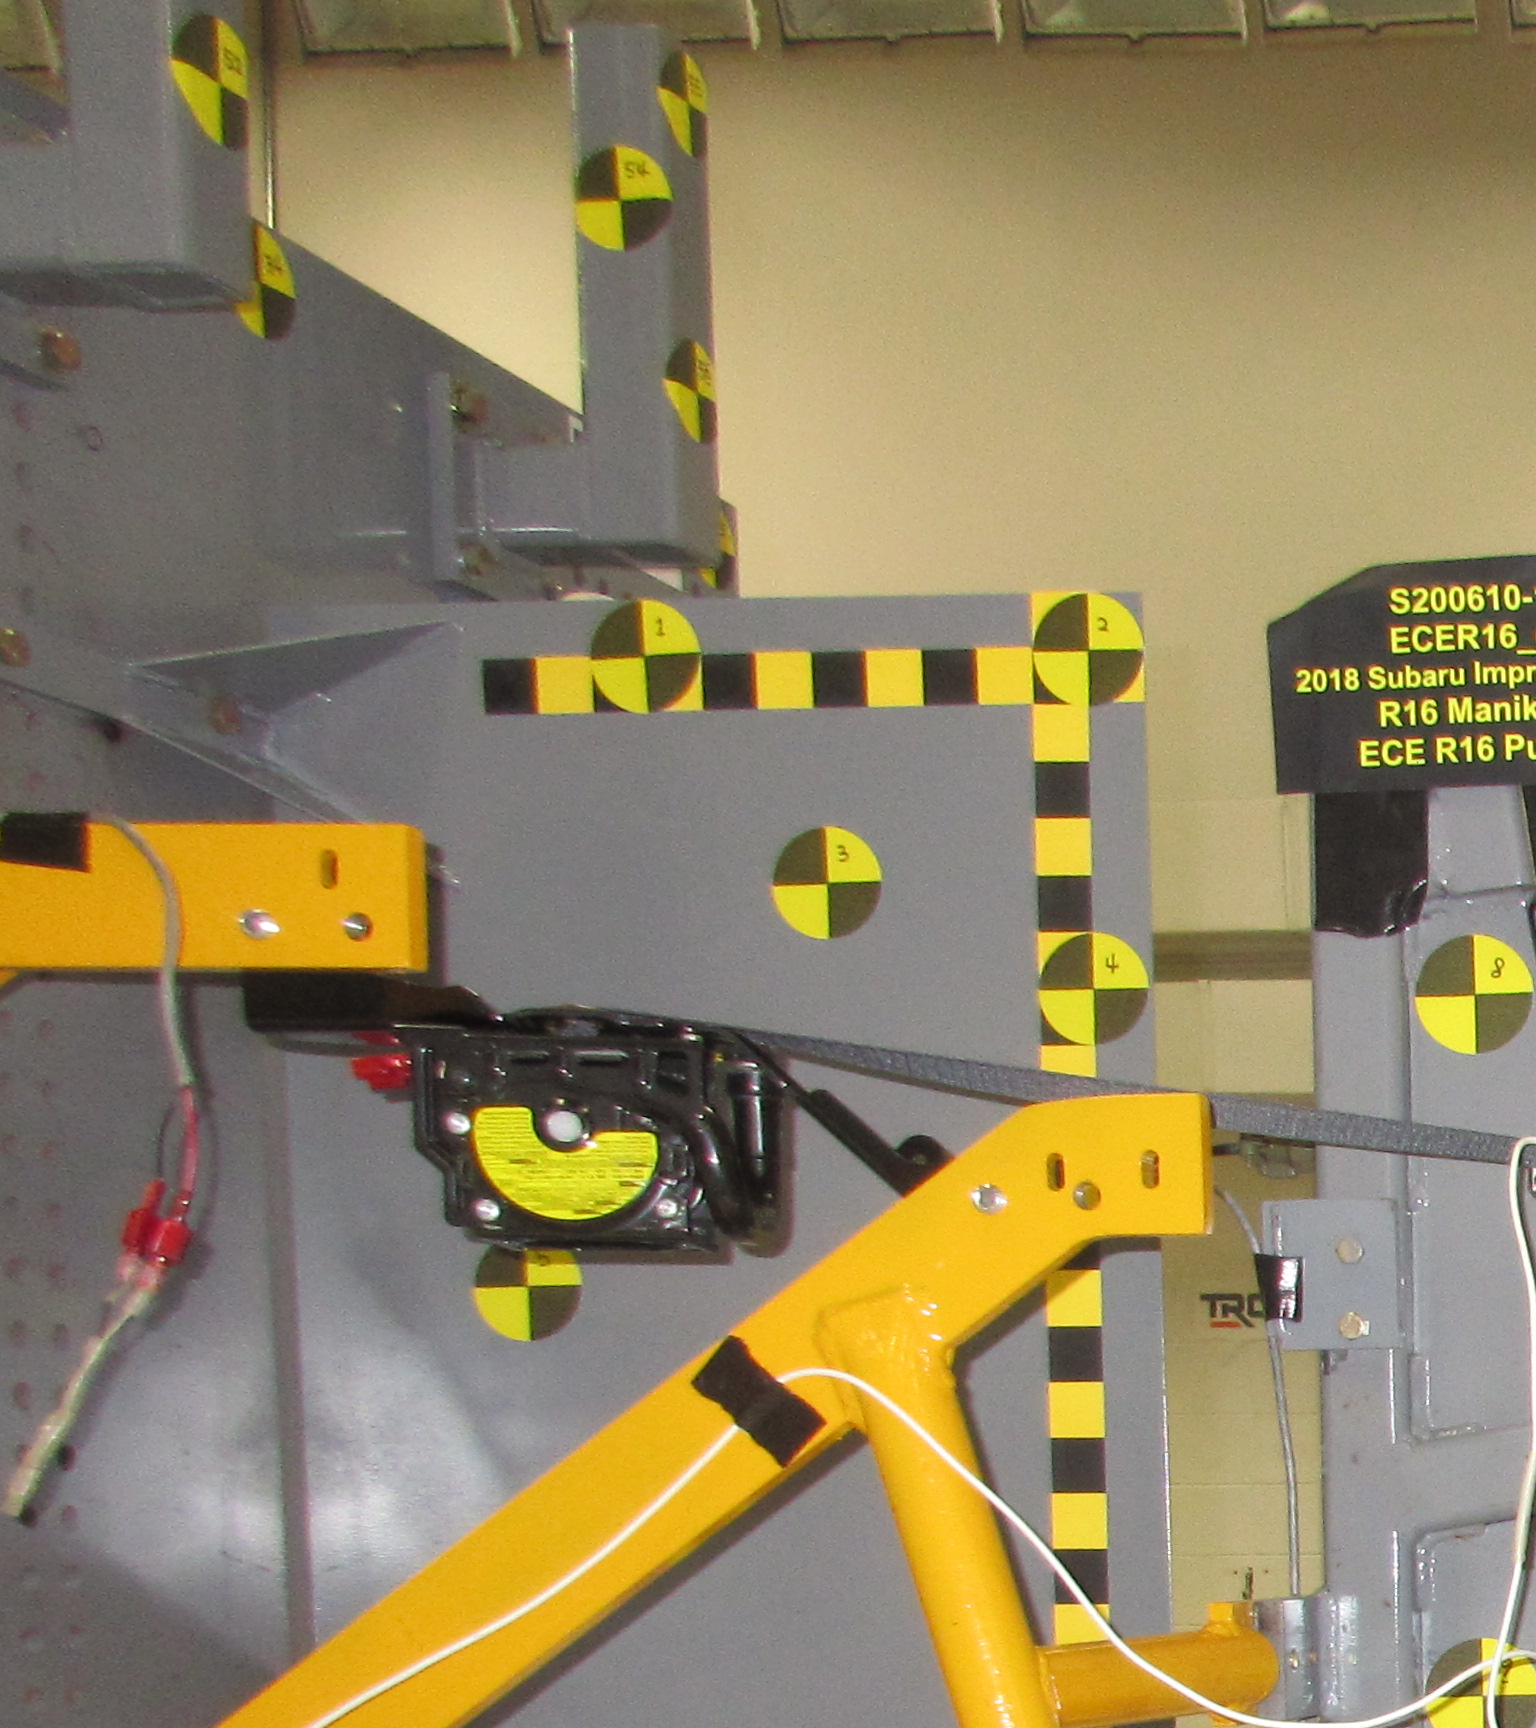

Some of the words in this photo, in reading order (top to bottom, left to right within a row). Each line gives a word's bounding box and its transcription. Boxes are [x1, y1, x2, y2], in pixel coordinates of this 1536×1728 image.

[1096, 616, 1110, 632] 2
[1295, 667, 1360, 693] 2018
[1367, 663, 1465, 691] Subaru
[1378, 698, 1439, 727] R16
[1358, 737, 1426, 768] ECE
[1434, 733, 1495, 764] R16
[836, 844, 850, 863] 3
[1105, 952, 1120, 975] 4
